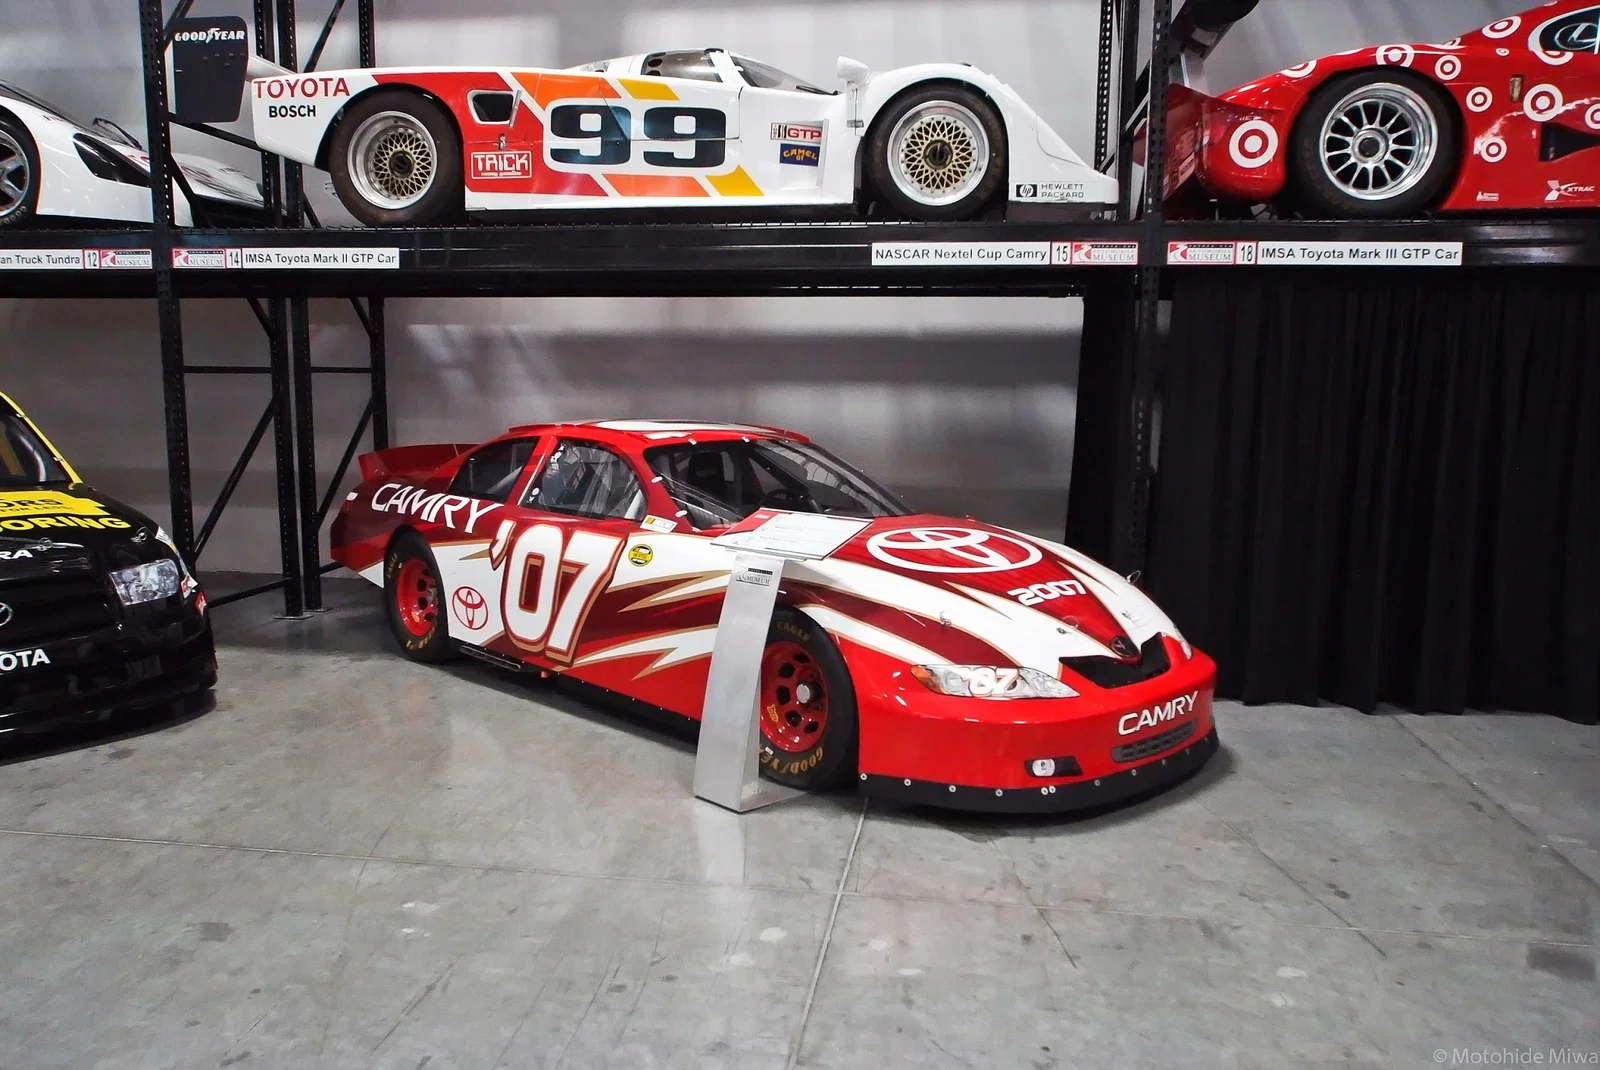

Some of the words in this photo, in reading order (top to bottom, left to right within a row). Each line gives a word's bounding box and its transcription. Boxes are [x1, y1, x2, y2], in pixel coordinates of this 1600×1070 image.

[174, 28, 246, 44] GOODYEAR
[253, 77, 350, 98] TOYOTA
[268, 105, 317, 118] BOSCH
[549, 104, 727, 168] 99
[787, 127, 822, 139] GTP
[783, 148, 818, 160] CAMEL
[474, 153, 529, 171] TRICK
[14, 254, 44, 264] Truck
[45, 254, 80, 264] Tundra
[87, 252, 98, 267] 12
[229, 251, 239, 266] 14
[245, 254, 273, 263] IMSA
[274, 254, 310, 265] Toyota
[313, 254, 339, 263] Mark
[341, 254, 348, 263] II
[351, 254, 374, 263] GTP
[377, 254, 396, 263] Car
[875, 248, 930, 259] NASCAR
[934, 248, 973, 259] Nextel
[977, 248, 1003, 262] Cup
[1006, 248, 1047, 262] Camry
[1056, 245, 1069, 262] 15
[1092, 253, 1136, 261] MUSEUM
[1188, 253, 1232, 261] MUSEUM
[1240, 245, 1254, 262] 18
[1260, 248, 1296, 259] IMSA
[1300, 248, 1344, 262] Toyota
[1348, 248, 1382, 259] Mark
[1385, 248, 1397, 259] III
[1401, 248, 1430, 260] GTP
[1435, 249, 1459, 260] Car
[371, 482, 504, 534] CAMRY
[0, 516, 131, 533] ORING
[1007, 579, 1087, 606] 2007
[1118, 691, 1199, 736] CAMRY
